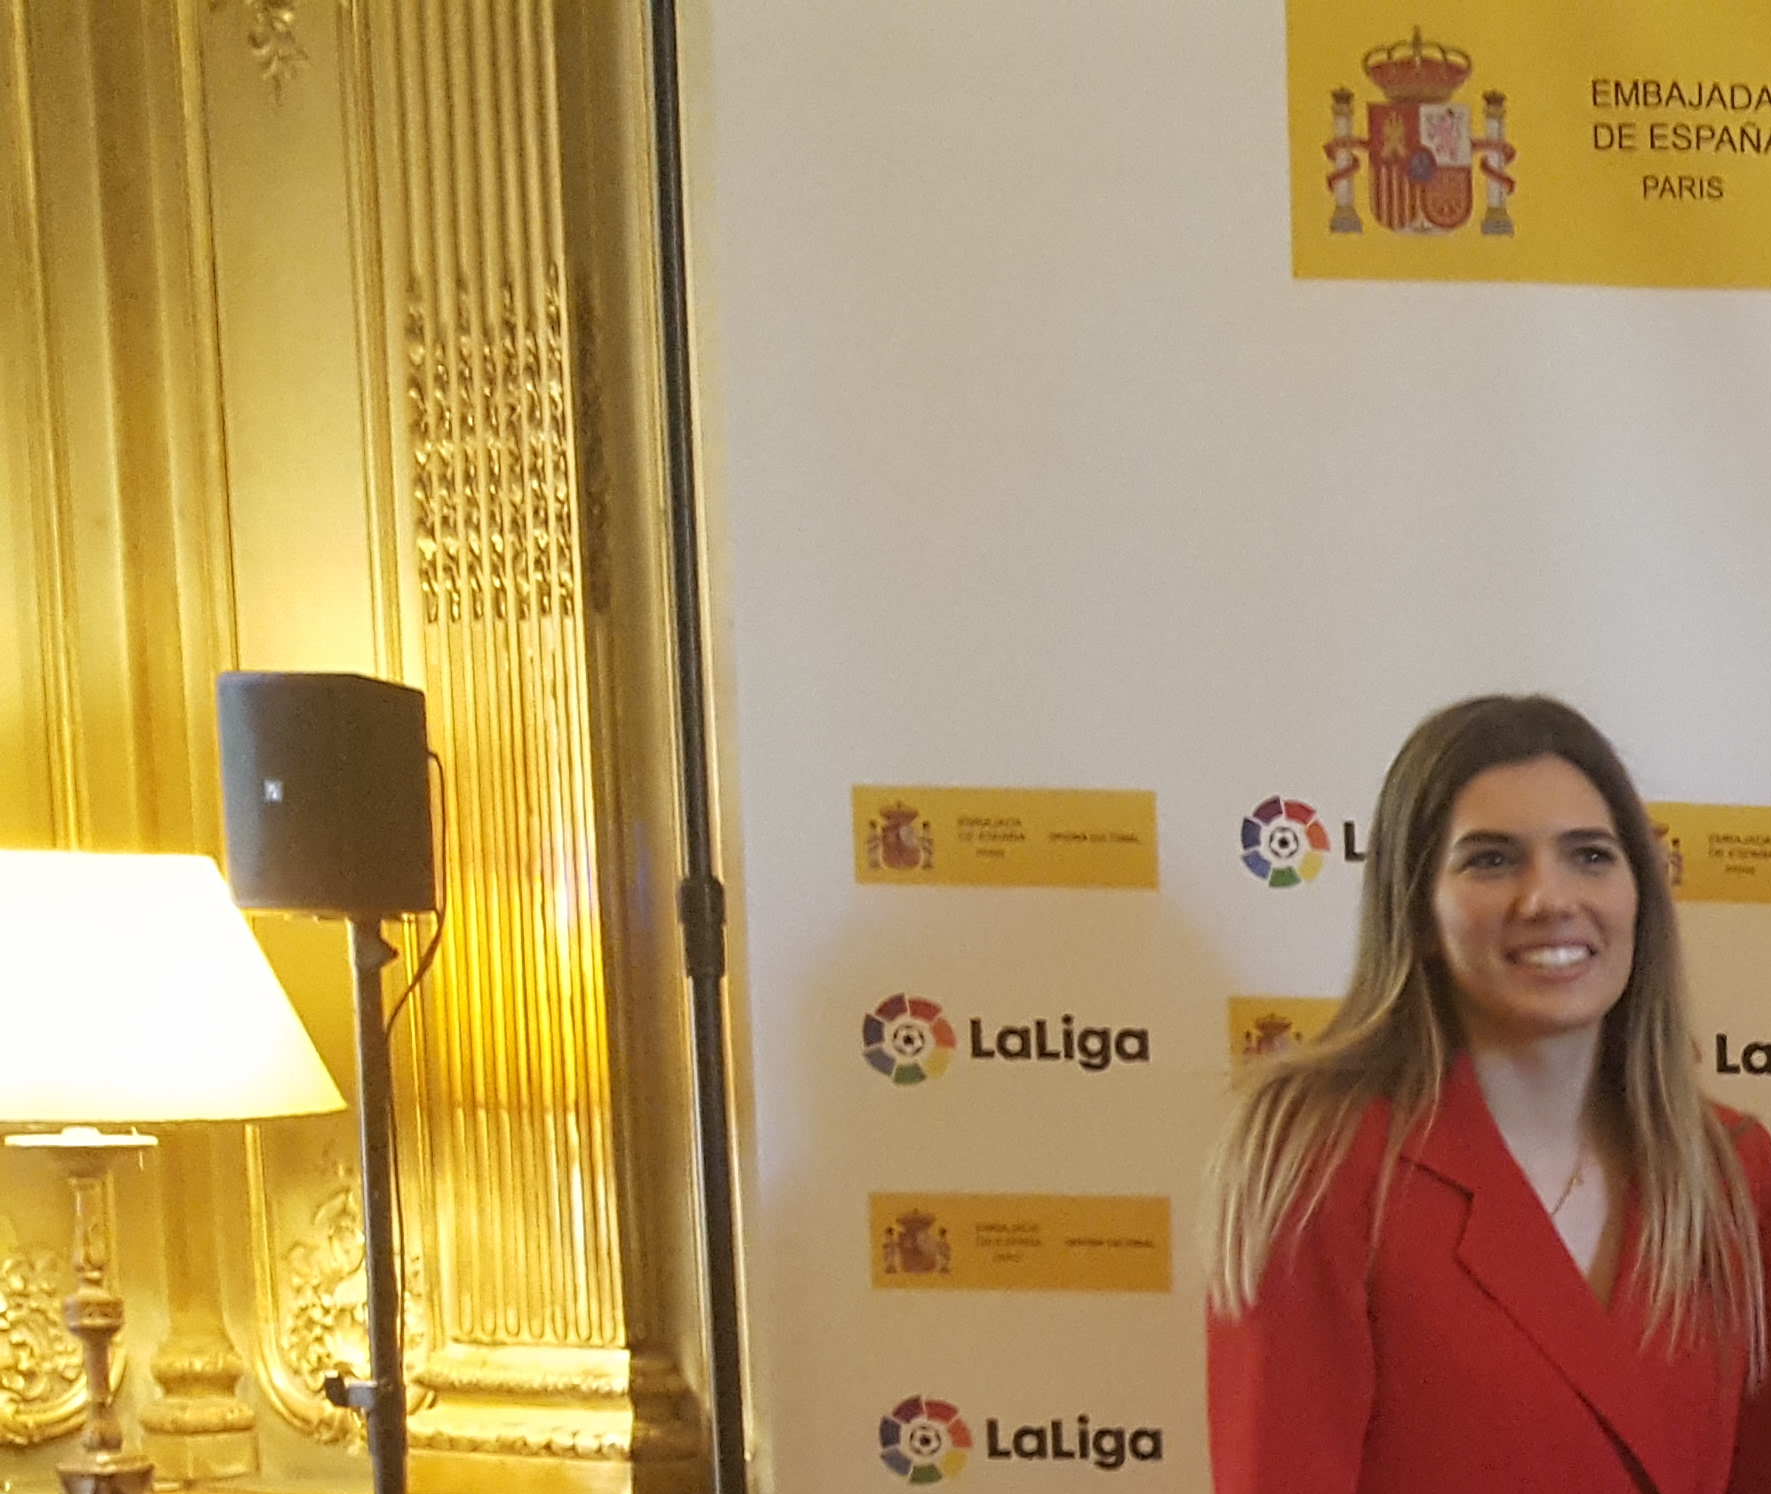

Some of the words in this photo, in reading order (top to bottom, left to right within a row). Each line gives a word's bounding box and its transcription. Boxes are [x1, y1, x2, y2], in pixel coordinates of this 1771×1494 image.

[1593, 122, 1634, 151] DE
[1642, 174, 1724, 200] PARIS
[971, 1015, 1149, 1071] LaLiga
[986, 1415, 1163, 1471] LaLiga
